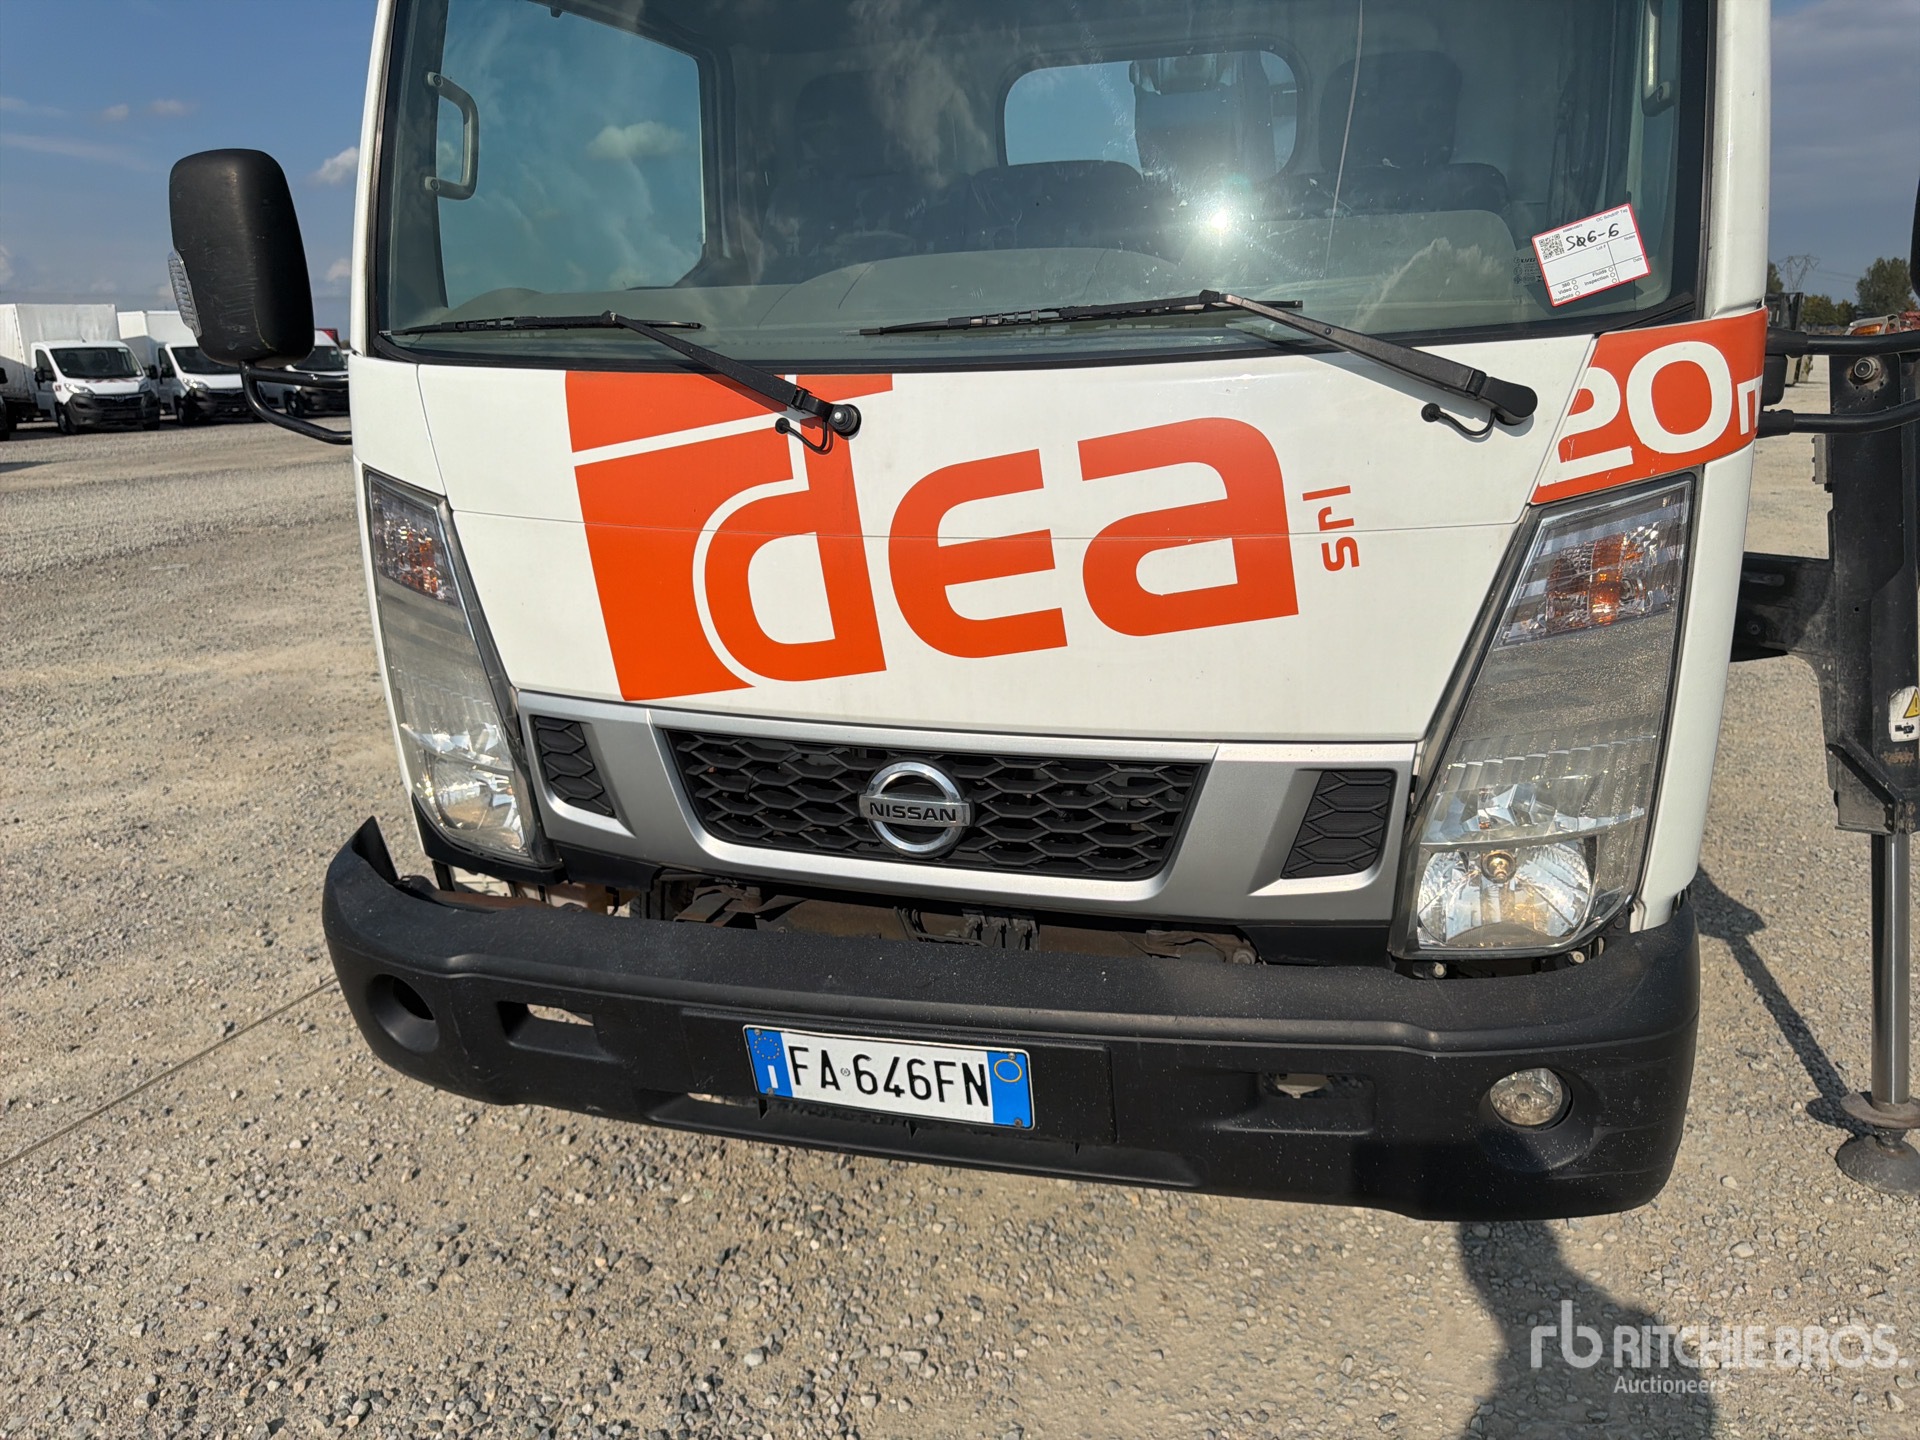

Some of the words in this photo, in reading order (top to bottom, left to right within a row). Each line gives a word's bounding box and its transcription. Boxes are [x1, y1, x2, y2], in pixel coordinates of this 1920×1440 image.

[1592, 269, 1607, 277] Fluids
[1584, 274, 1609, 286] Inspection
[1558, 287, 1572, 295] Video
[1302, 485, 1360, 572] srl
[869, 802, 957, 823] NISSAN
